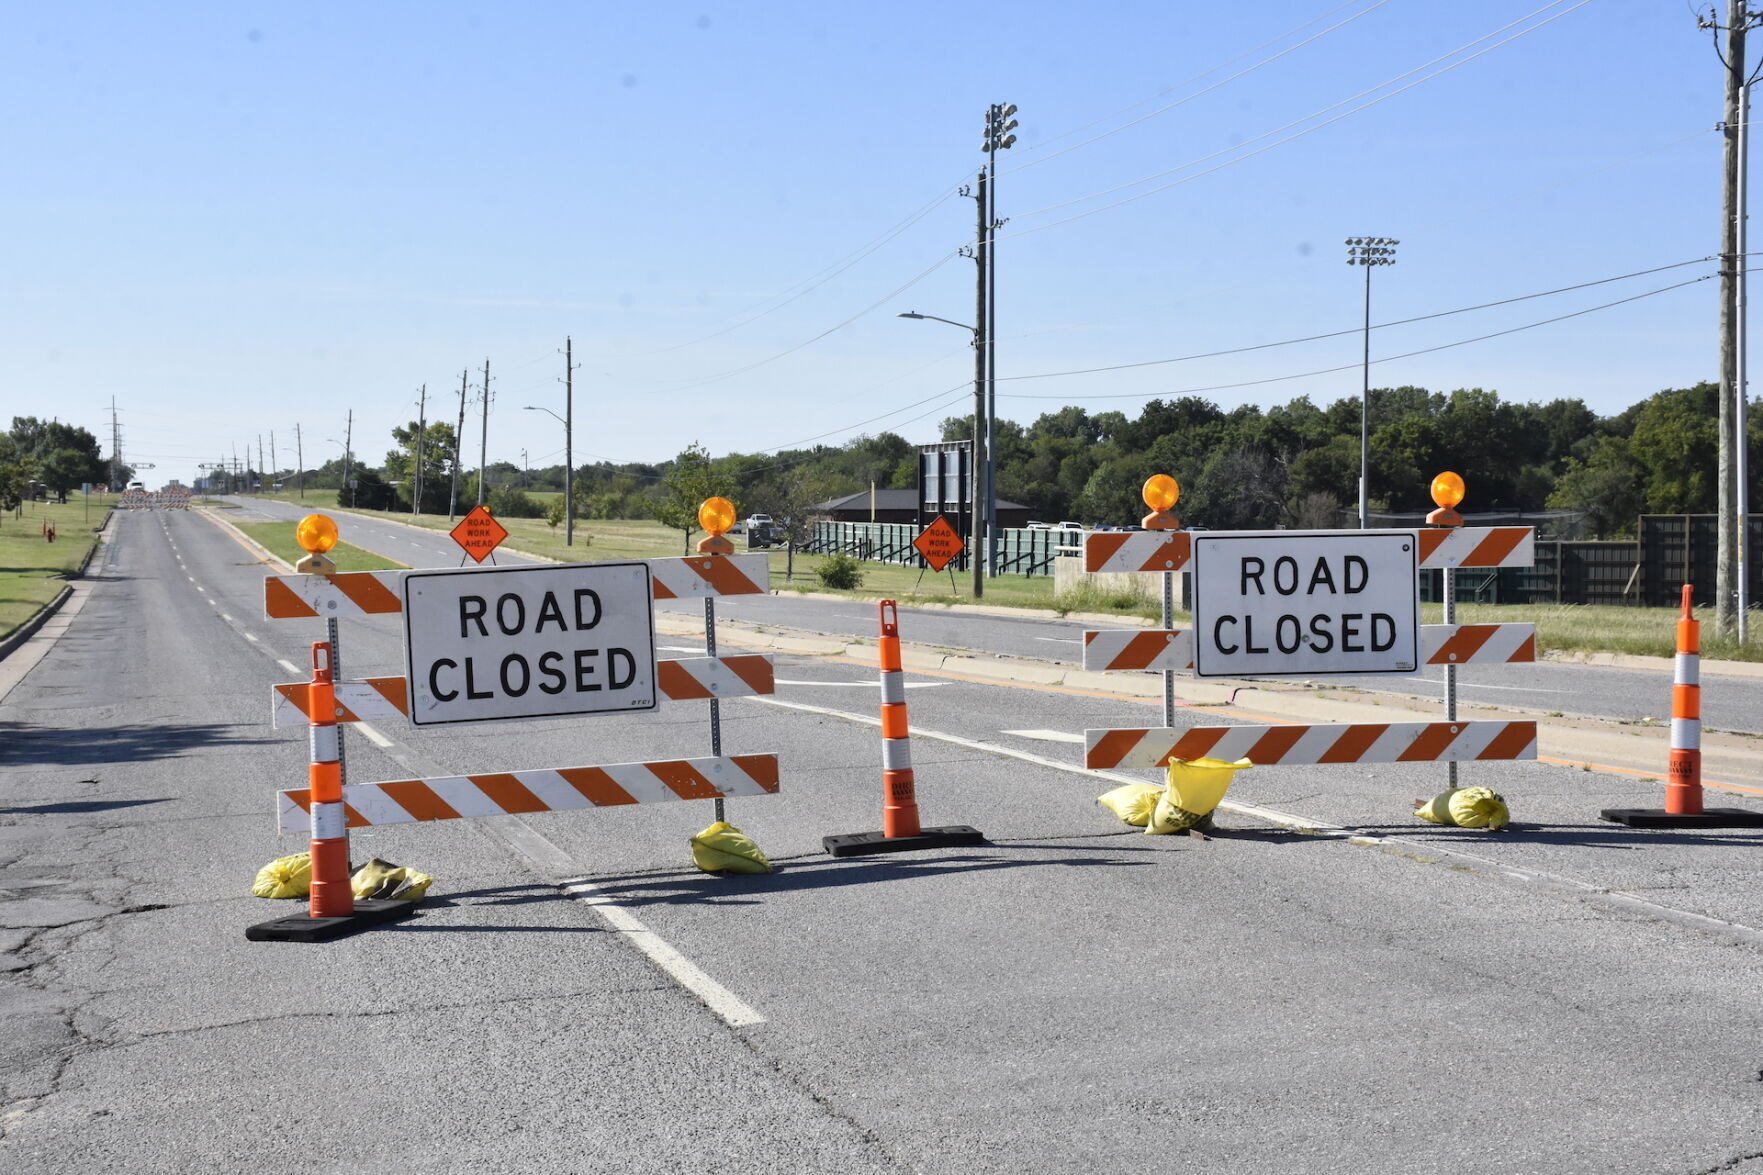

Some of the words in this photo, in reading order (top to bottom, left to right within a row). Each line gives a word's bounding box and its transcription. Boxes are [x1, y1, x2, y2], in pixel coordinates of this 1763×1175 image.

[930, 529, 951, 537] ROAD
[926, 550, 952, 558] AHEAD
[1241, 555, 1369, 596] ROAD
[459, 588, 603, 638] ROAD
[1213, 613, 1397, 655] CLOSED
[429, 647, 636, 703] CLOSED
